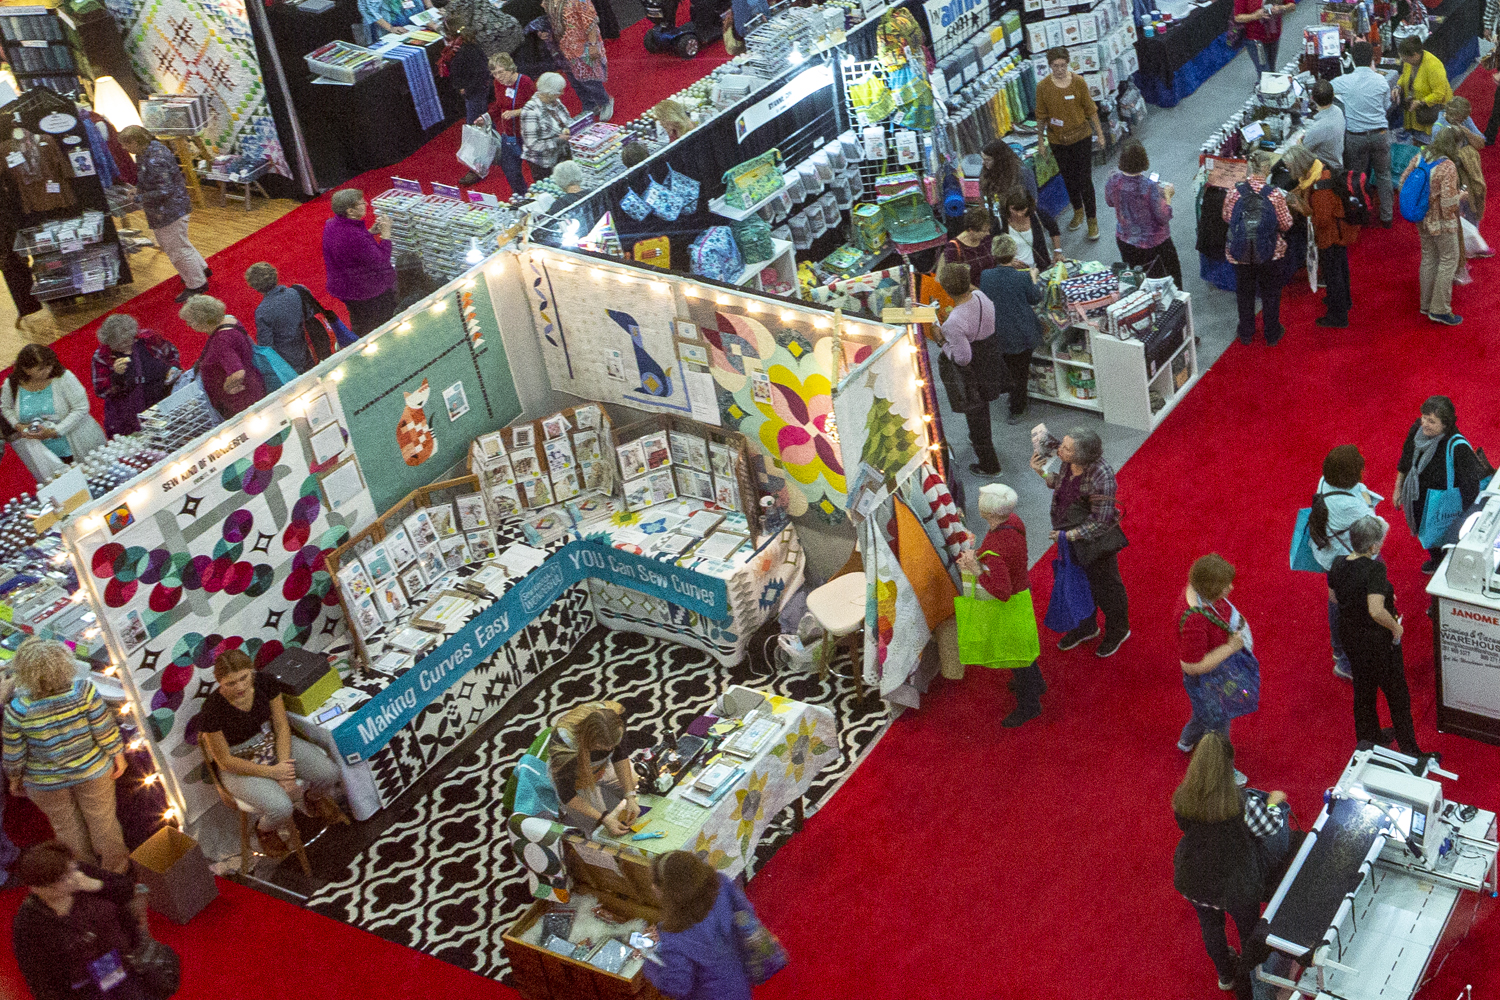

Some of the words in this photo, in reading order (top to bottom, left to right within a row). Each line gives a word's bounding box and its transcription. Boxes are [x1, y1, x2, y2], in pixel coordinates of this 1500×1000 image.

[161, 476, 180, 492] SEW
[1451, 607, 1500, 626] JANOME
[357, 686, 418, 745] Making
[418, 642, 474, 694] Curves
[474, 609, 510, 649] Easy
[569, 548, 604, 571] YOU
[609, 553, 636, 578] Can
[637, 563, 669, 590] Sew
[672, 576, 716, 608] Curves
